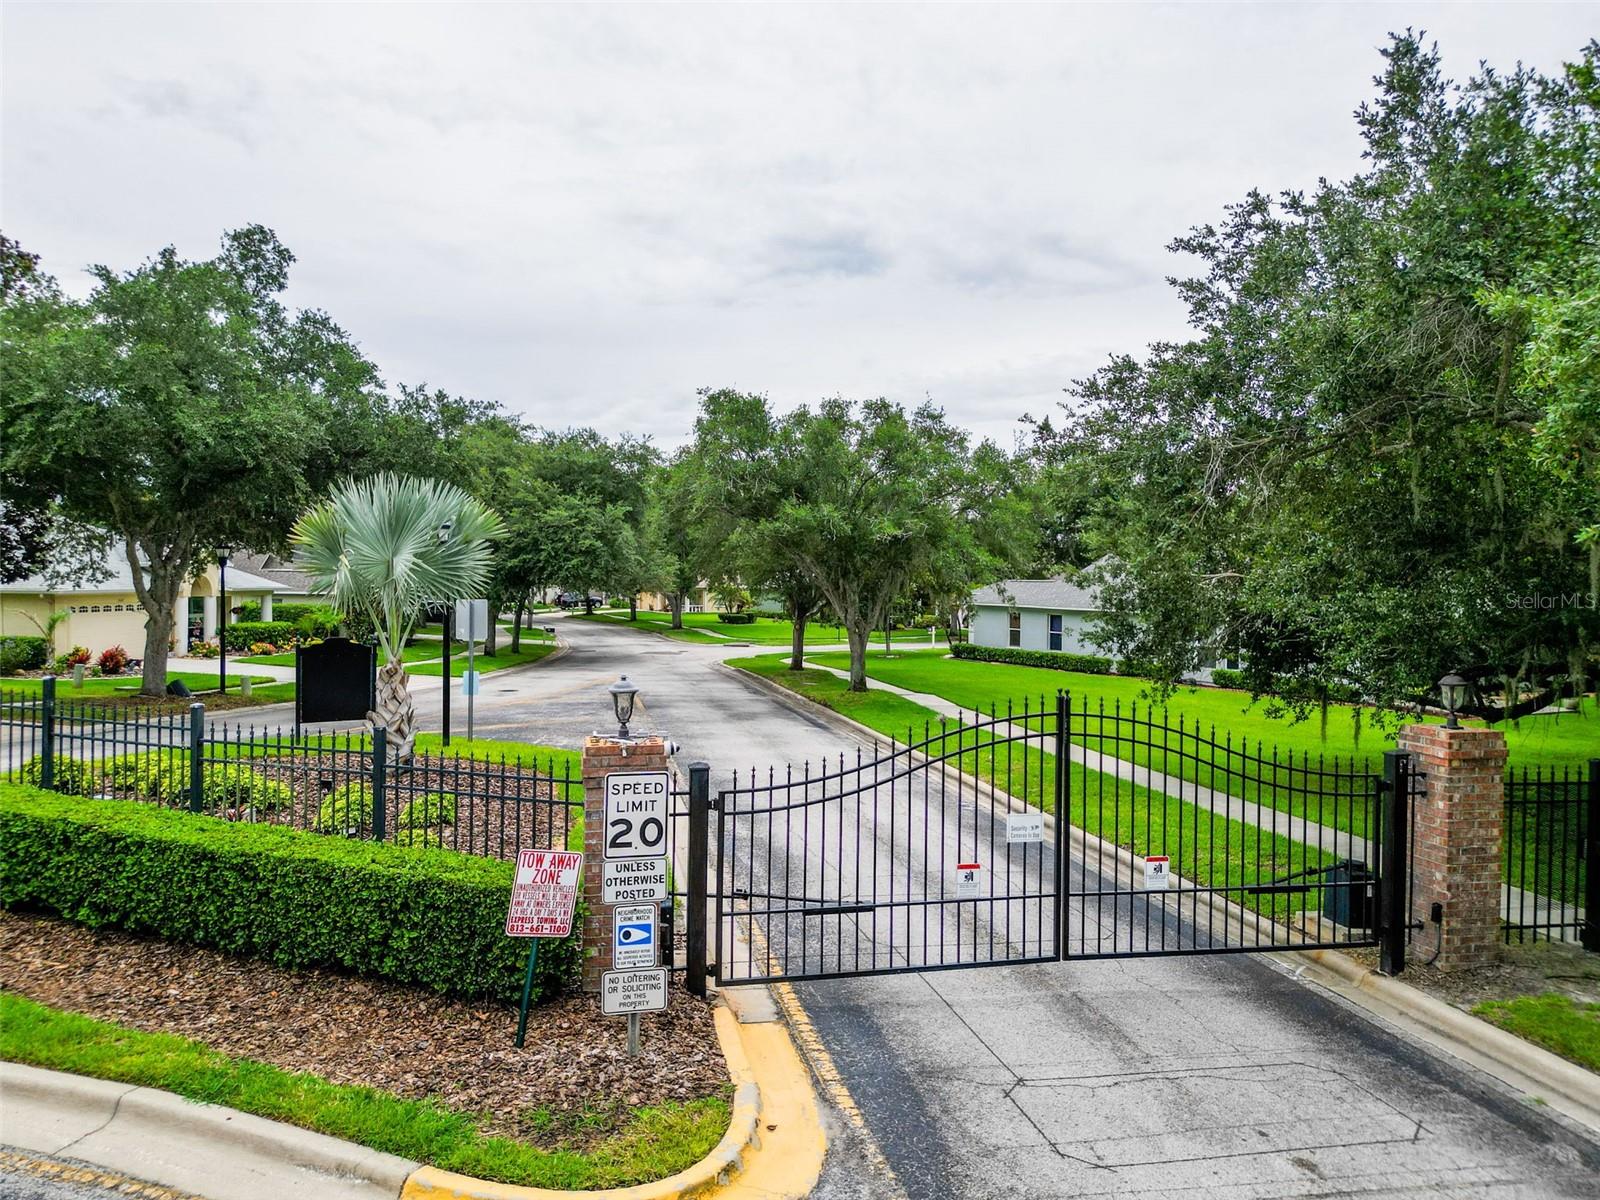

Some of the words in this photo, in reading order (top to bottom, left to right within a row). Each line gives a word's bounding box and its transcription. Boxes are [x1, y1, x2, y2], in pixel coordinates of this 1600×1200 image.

[611, 783, 663, 795] SPEED
[616, 800, 657, 813] LIMIT
[609, 817, 663, 848] 20
[522, 853, 546, 868] TOW
[549, 855, 579, 870] AWAY
[615, 862, 656, 873] UNLESS
[532, 869, 563, 884] ZONE
[605, 875, 665, 887] OTHERWISE
[516, 884, 552, 893] UNAUTHORIZED
[553, 885, 575, 893] VEHICLES
[615, 888, 655, 900] POSTED
[523, 892, 540, 900] VESSELS
[618, 908, 652, 916] NEIGHBORHOOD
[509, 924, 567, 932] 813-661-1100
[623, 974, 661, 983] LOITERING
[608, 986, 618, 994] OR
[622, 983, 662, 993] SOLICITING
[619, 1000, 650, 1008] PROPERTY
